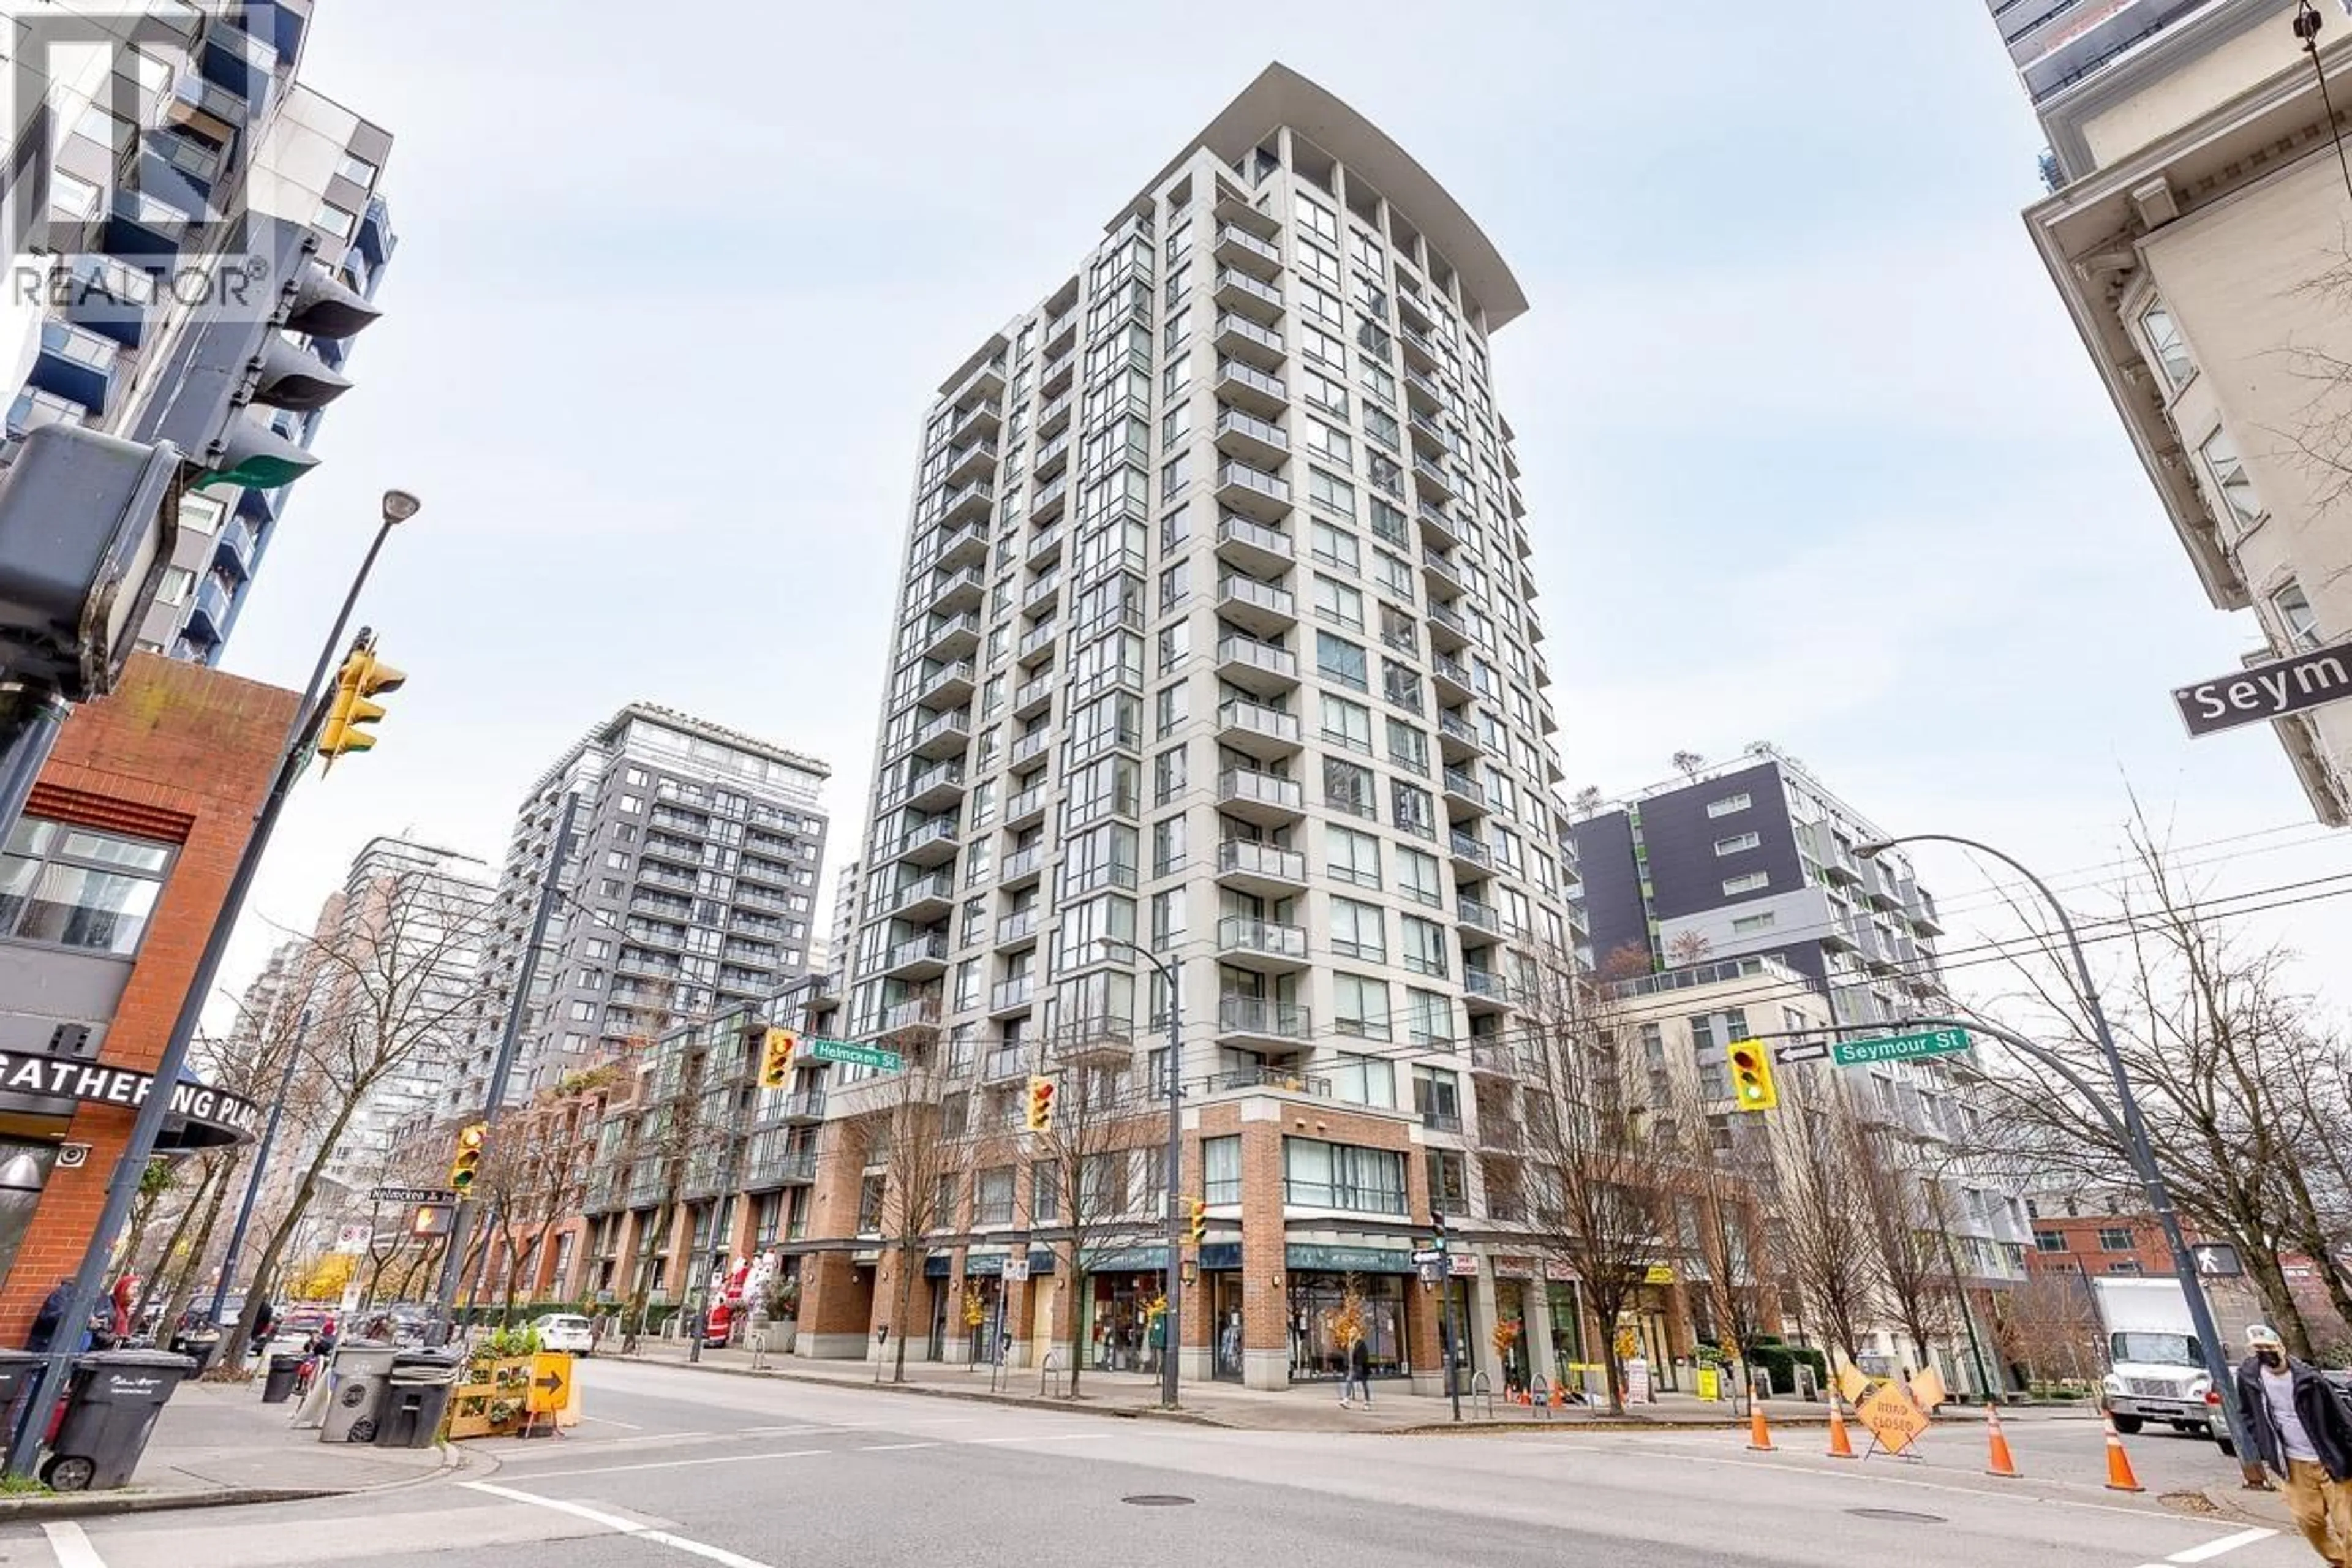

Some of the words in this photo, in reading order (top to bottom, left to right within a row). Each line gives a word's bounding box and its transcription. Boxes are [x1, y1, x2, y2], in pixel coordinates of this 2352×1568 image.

[2195, 657, 2350, 718] Seym
[819, 1043, 878, 1065] Helmcken
[882, 1055, 895, 1068] St
[1842, 1039, 1927, 1060] Seymour
[1936, 1033, 1959, 1049] St
[0, 1054, 214, 1119] ATHENG
[1877, 1401, 1909, 1415] ROAD
[1873, 1417, 1914, 1431] CLOSED
